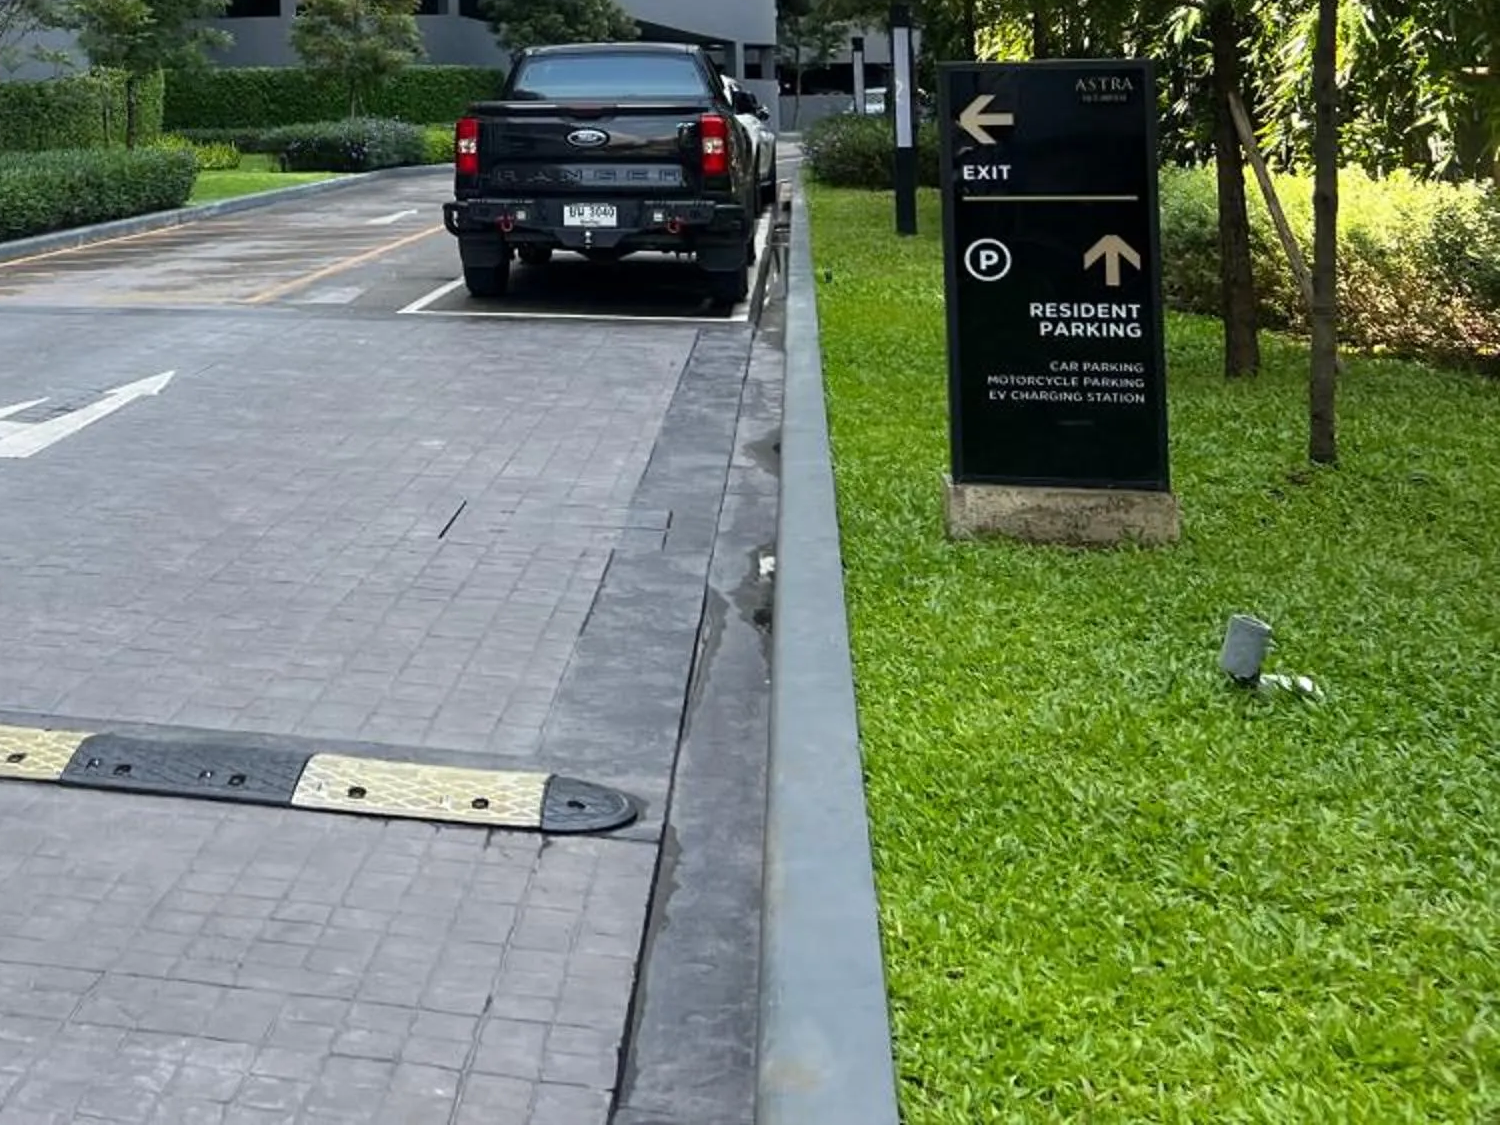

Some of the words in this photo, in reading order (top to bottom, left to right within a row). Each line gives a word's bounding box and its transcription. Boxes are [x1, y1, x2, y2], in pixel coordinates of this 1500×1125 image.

[1075, 76, 1134, 91] ASTRA
[499, 169, 680, 182] RANGER
[963, 164, 1012, 180] EXIT
[979, 250, 999, 270] P
[1029, 302, 1141, 319] RESIDENT
[1039, 322, 1143, 338] PARKING
[1049, 361, 1079, 372] CAR
[1083, 362, 1145, 373] PARKING
[987, 375, 1079, 387] MOTORCYCLE
[1083, 376, 1145, 388] PARKING
[989, 390, 1007, 400] EV
[1011, 390, 1083, 402] CHARGING
[1087, 392, 1146, 404] STATION
